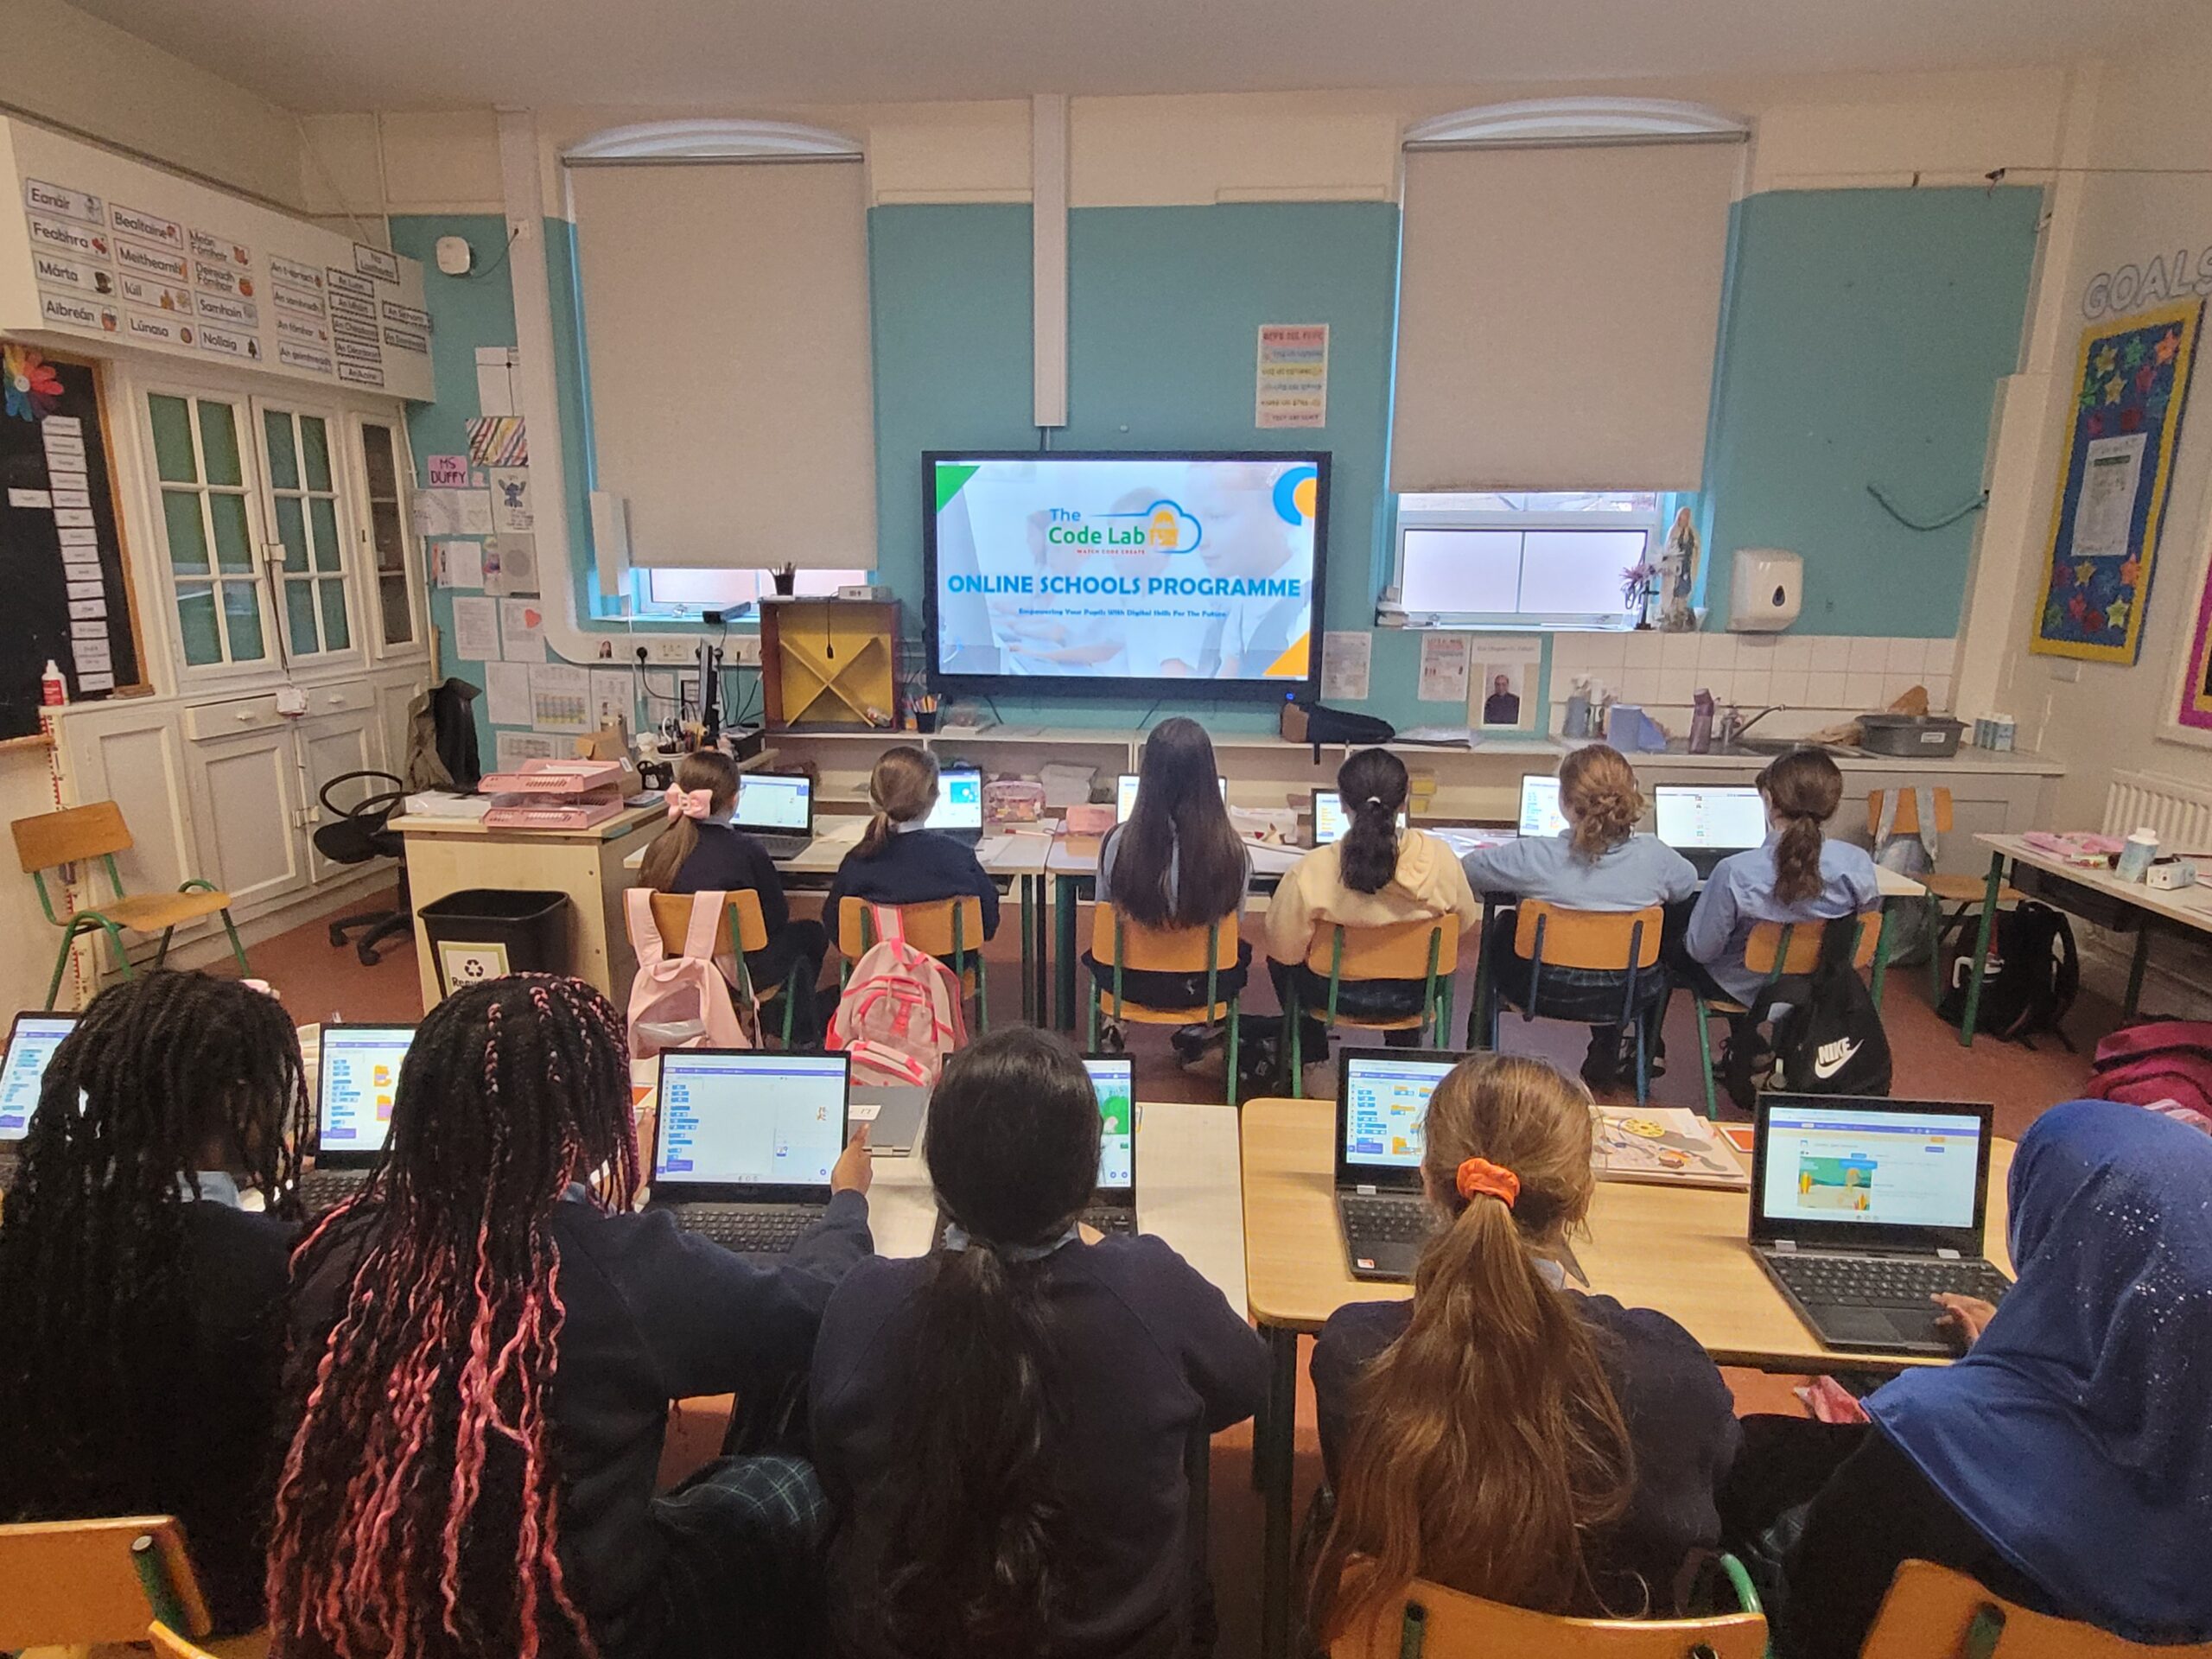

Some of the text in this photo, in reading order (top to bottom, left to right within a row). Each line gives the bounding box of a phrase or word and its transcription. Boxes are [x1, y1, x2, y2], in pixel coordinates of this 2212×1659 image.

[31, 188, 71, 210] Eanáir
[33, 222, 88, 248] Feabhra
[114, 212, 168, 239] Bealtaine
[38, 260, 79, 282] Márta
[47, 300, 95, 322] Aibreán
[200, 298, 243, 319] Samhain
[130, 319, 169, 338] Lúnasa
[203, 332, 238, 352] Nollaig
[439, 458, 457, 470] MS
[430, 470, 467, 485] DUFFY
[1049, 508, 1081, 522] The
[1048, 525, 1146, 545] Code Lab
[948, 575, 1301, 596] ONLINE SCHOOLS PROGRAMME
[1019, 607, 1064, 616] Empowering
[1084, 608, 1106, 617] Pupils
[1127, 609, 1152, 618] Digital
[1818, 1037, 1854, 1065] NIKE
